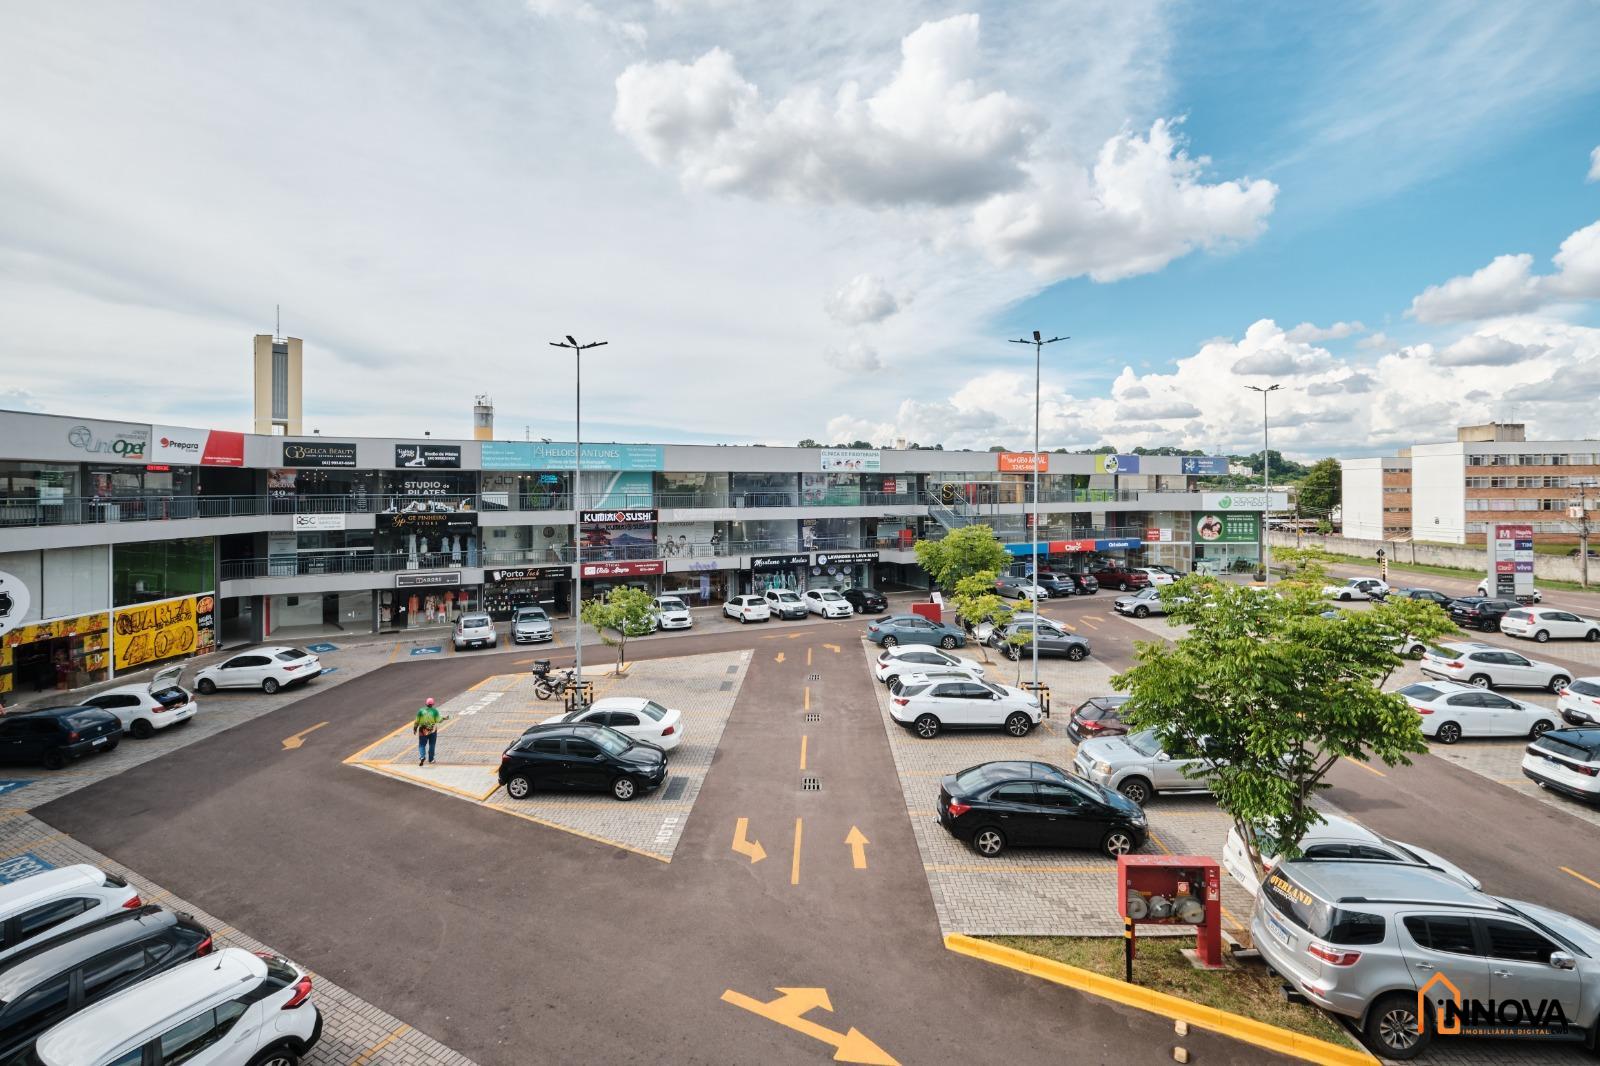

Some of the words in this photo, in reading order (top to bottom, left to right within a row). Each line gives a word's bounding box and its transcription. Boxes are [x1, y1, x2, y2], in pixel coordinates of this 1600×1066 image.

[169, 440, 199, 450] Prepara
[545, 448, 580, 457] HELOIS
[581, 449, 620, 458] ANTUNES
[404, 481, 441, 489] STUDIO
[625, 512, 651, 521] SUSHI
[1065, 543, 1080, 551] Claro
[501, 570, 524, 578] Porto
[116, 599, 192, 635] QUARTA
[1270, 874, 1313, 906] OVERLAND
